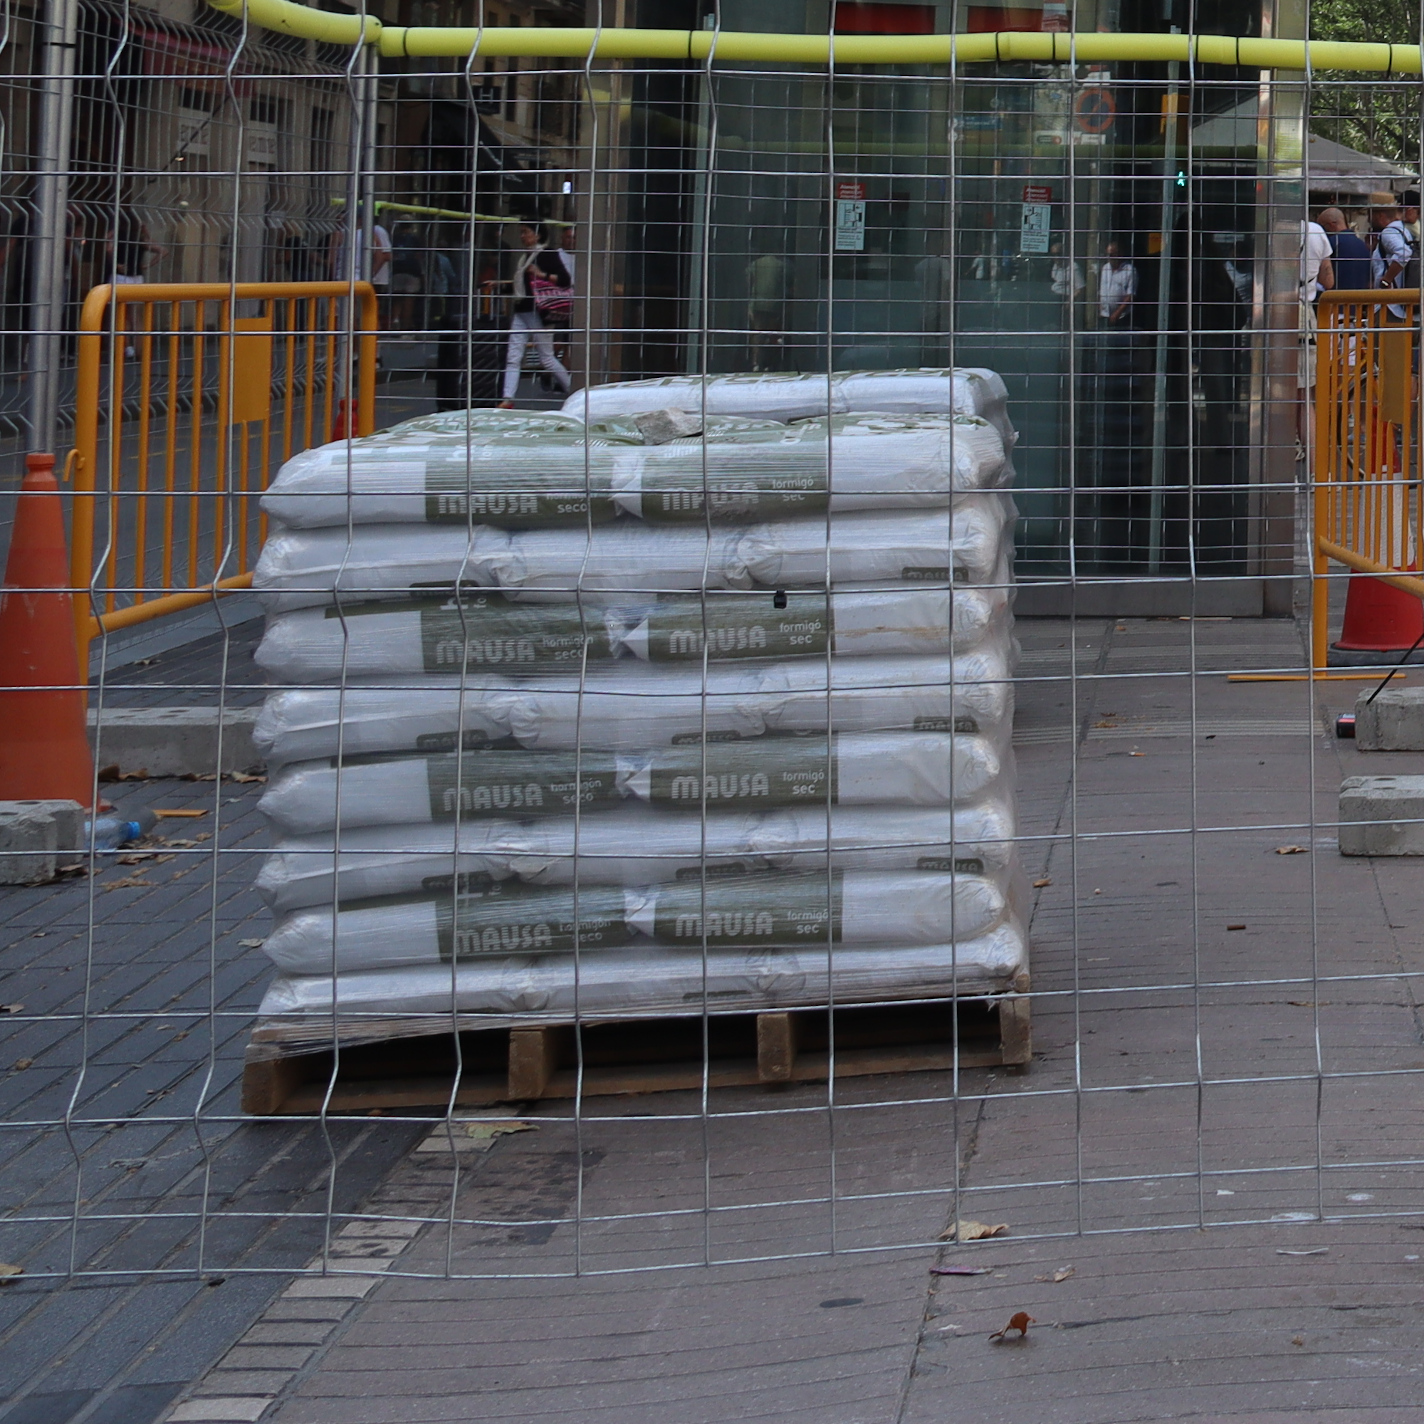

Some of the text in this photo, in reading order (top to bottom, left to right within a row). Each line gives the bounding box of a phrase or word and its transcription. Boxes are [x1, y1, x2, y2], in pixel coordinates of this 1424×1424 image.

[772, 476, 814, 490] formigó
[557, 503, 588, 514] seco
[779, 619, 821, 633] formigó
[789, 634, 813, 646] sec
[783, 769, 825, 783] formigó
[792, 783, 816, 795] sec
[787, 908, 829, 922] formigó
[796, 923, 820, 935] sec
